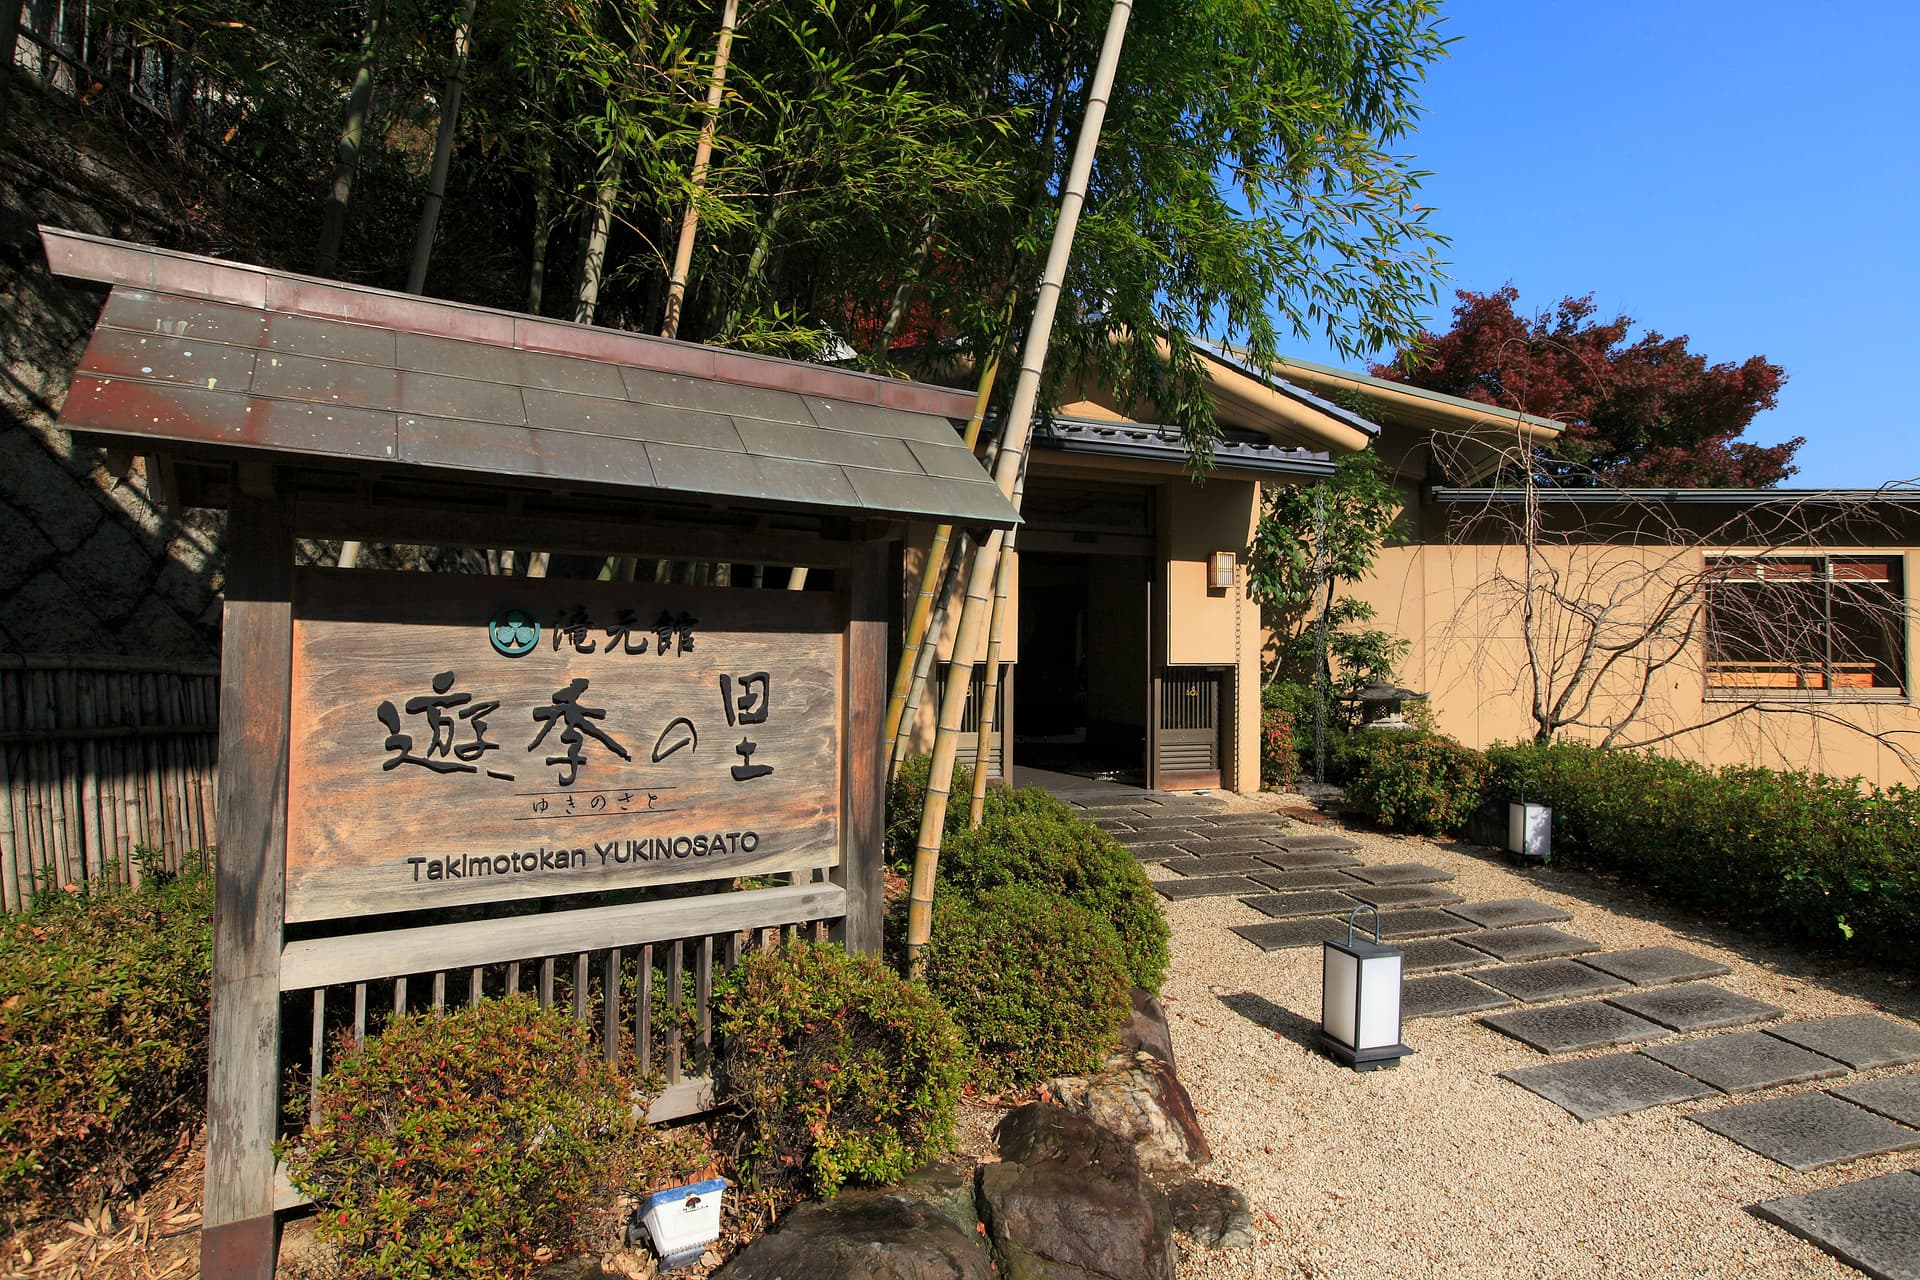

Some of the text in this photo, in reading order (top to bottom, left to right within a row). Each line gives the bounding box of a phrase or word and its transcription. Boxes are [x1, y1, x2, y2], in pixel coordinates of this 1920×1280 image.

[552, 603, 698, 657] 滝元館
[377, 671, 774, 786] 遊季の里
[533, 792, 658, 815] ゆきのさと
[407, 831, 760, 882] Takimotokan YUKINOSATO
